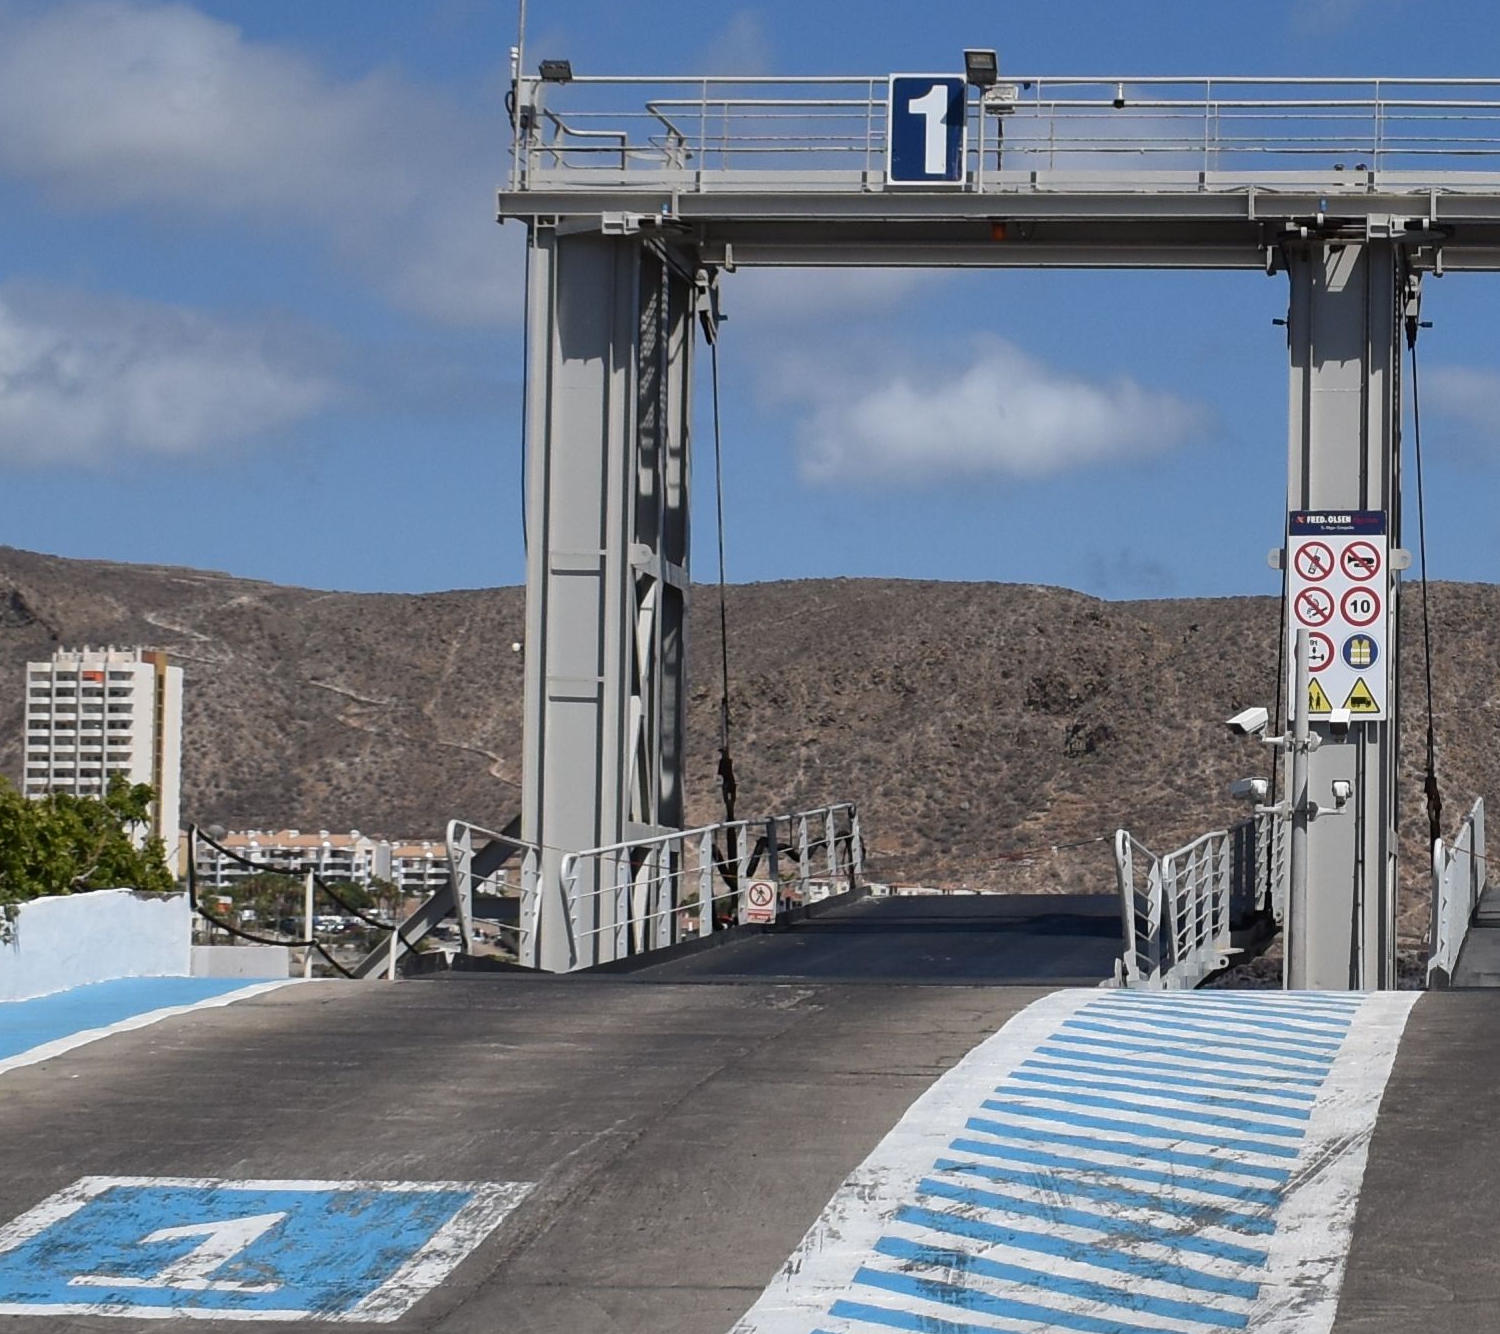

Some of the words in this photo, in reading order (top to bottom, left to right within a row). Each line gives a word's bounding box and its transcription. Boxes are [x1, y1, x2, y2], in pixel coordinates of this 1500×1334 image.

[908, 84, 948, 174] 1
[1350, 599, 1371, 614] 10
[67, 1211, 288, 1293] 1
